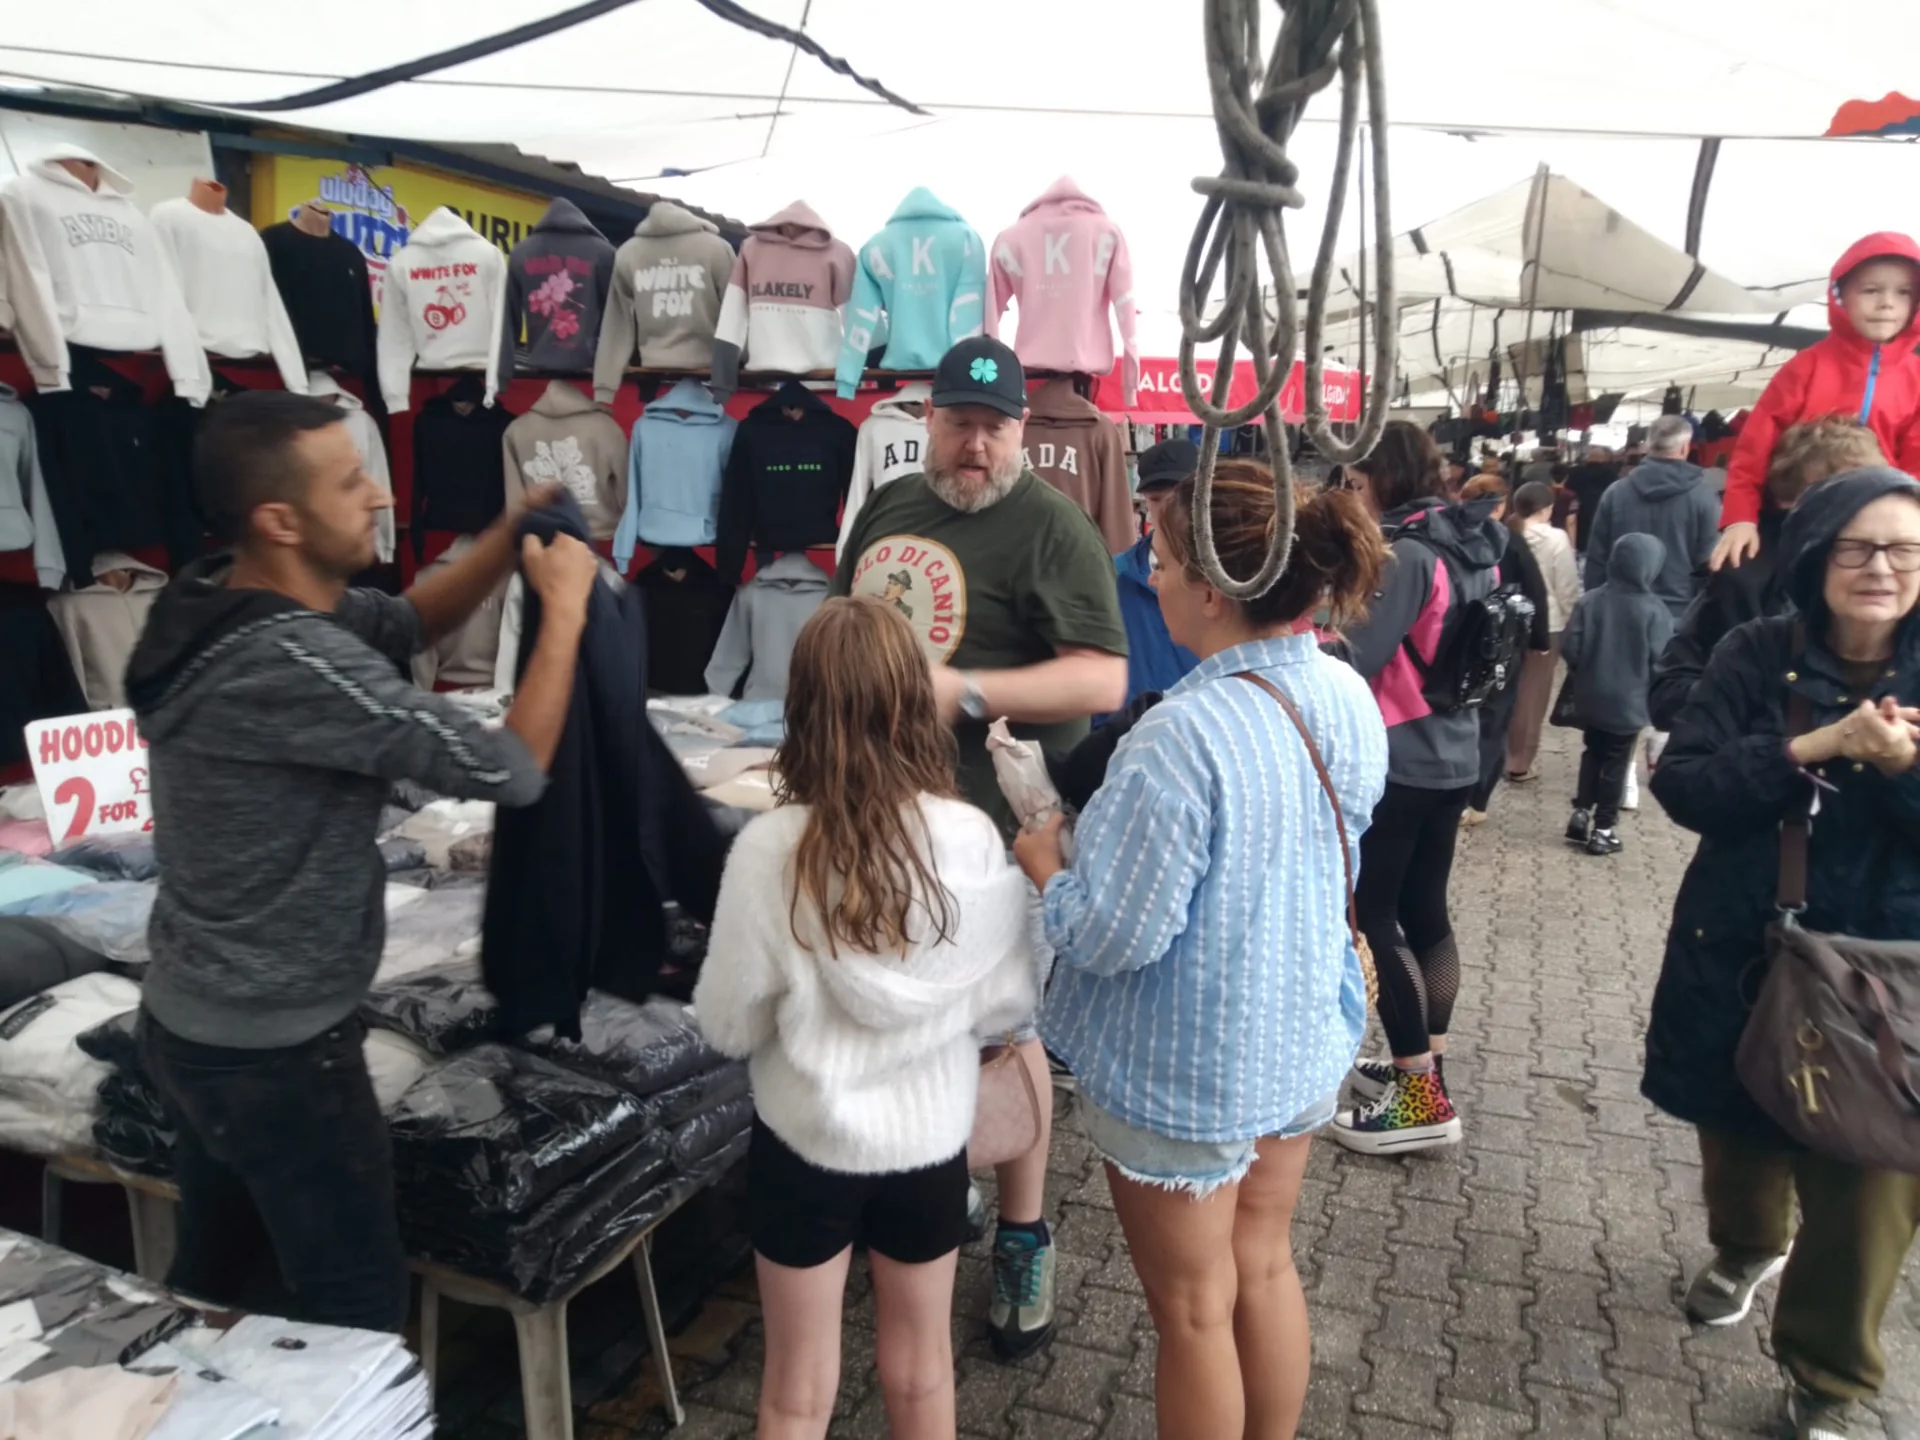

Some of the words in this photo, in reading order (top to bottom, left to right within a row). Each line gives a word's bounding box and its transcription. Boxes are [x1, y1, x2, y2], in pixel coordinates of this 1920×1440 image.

[912, 234, 937, 276] K
[1044, 231, 1072, 276] K
[633, 264, 706, 293] WHITE
[751, 282, 815, 300] BLAKELY
[651, 290, 695, 319] FOX
[897, 545, 928, 567] DI
[923, 559, 954, 644] CANIO
[39, 719, 150, 765] HOODI
[54, 776, 96, 841] 2
[98, 800, 138, 824] FOR
